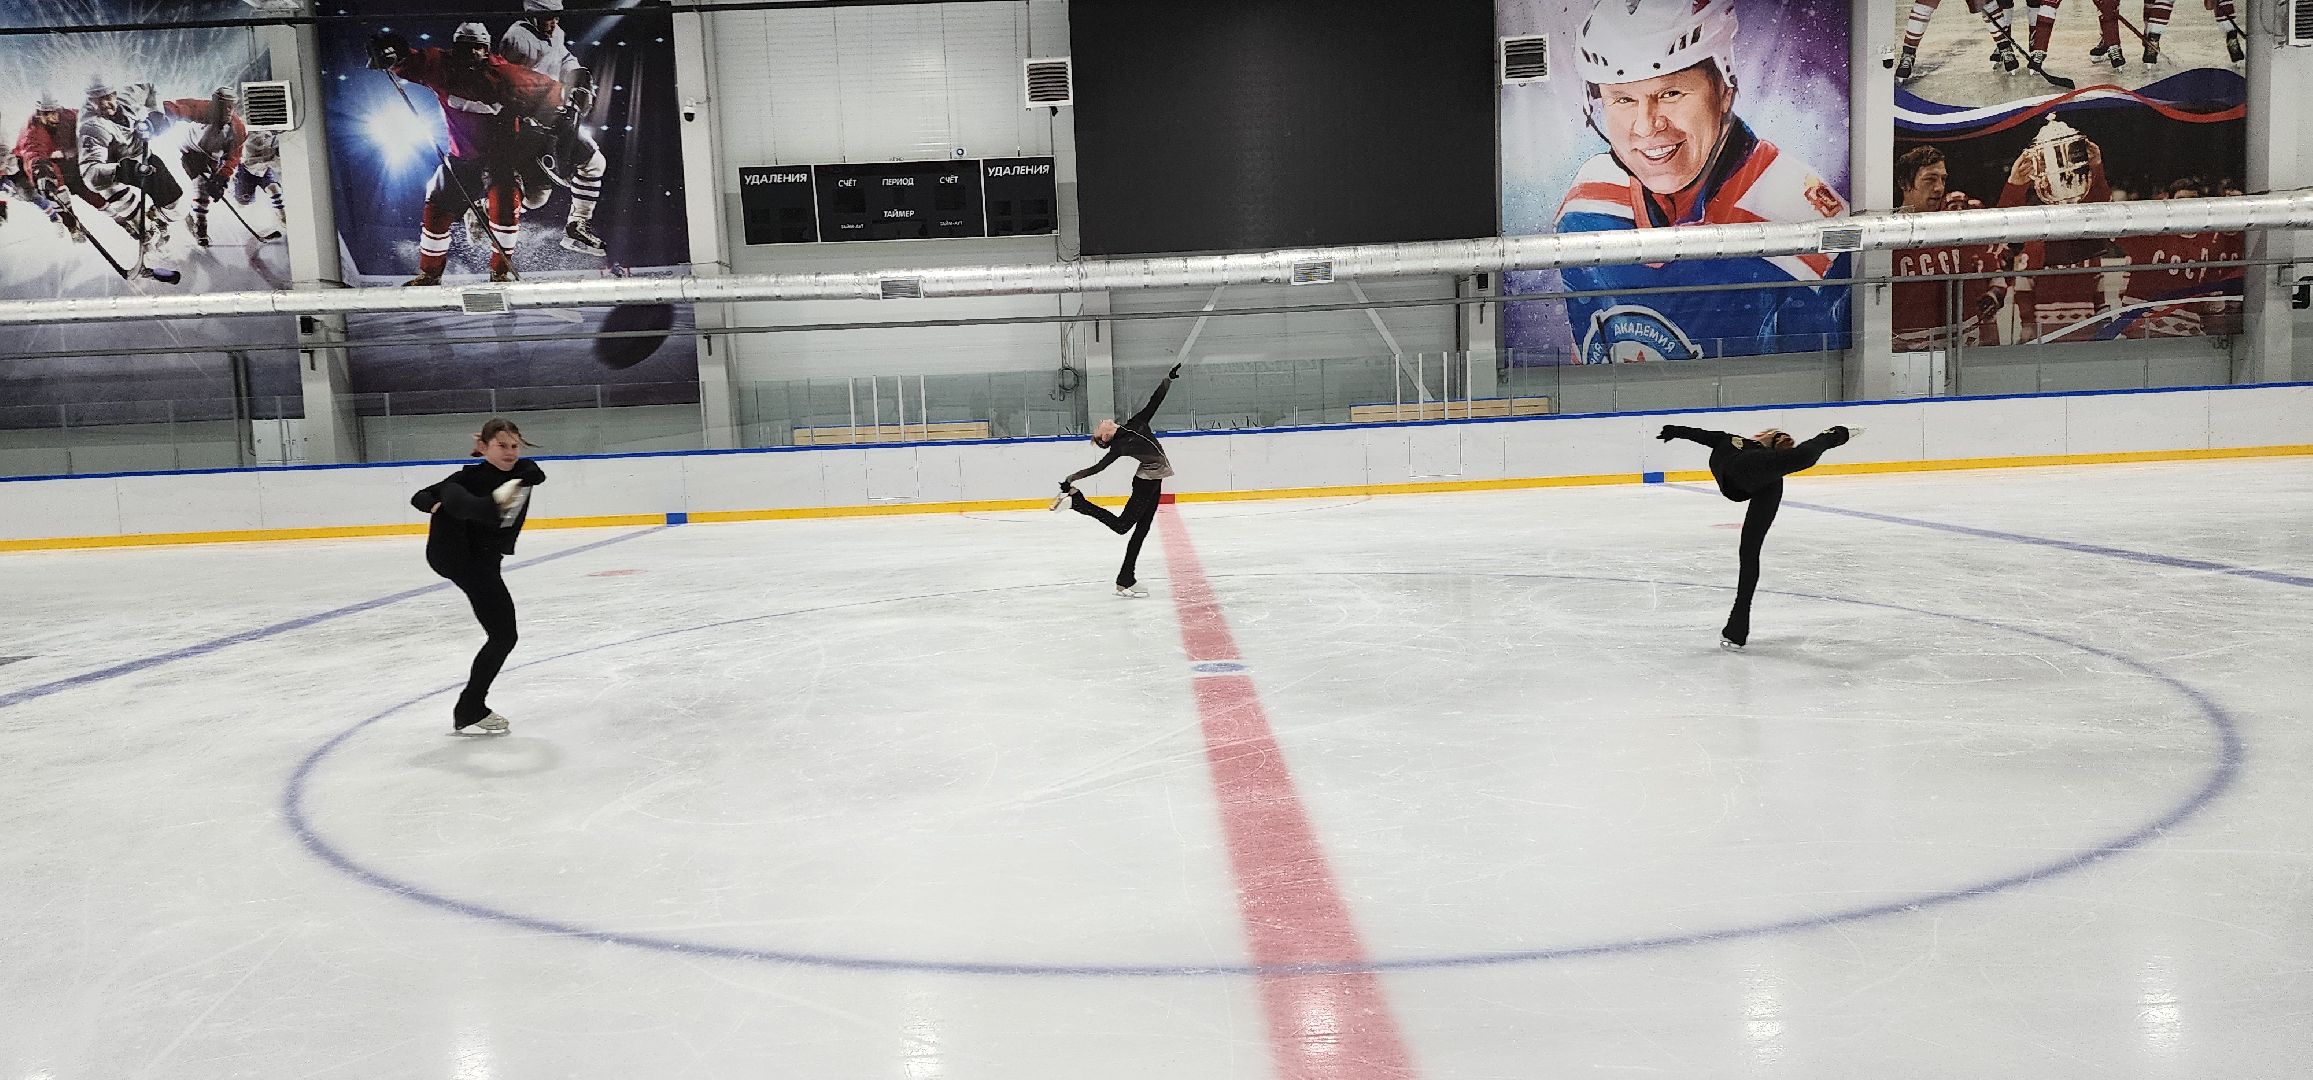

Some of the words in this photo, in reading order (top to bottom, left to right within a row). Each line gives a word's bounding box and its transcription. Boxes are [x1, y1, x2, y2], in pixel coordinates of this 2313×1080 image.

[987, 164, 1050, 177] УДАЛЕНИЯ
[744, 173, 808, 186] УДАЛЕНИЯ
[882, 177, 915, 187] ПЕРИОД
[883, 209, 915, 218] ТАЙМЕР
[1613, 321, 1676, 354] АКАДЕМИЯ
